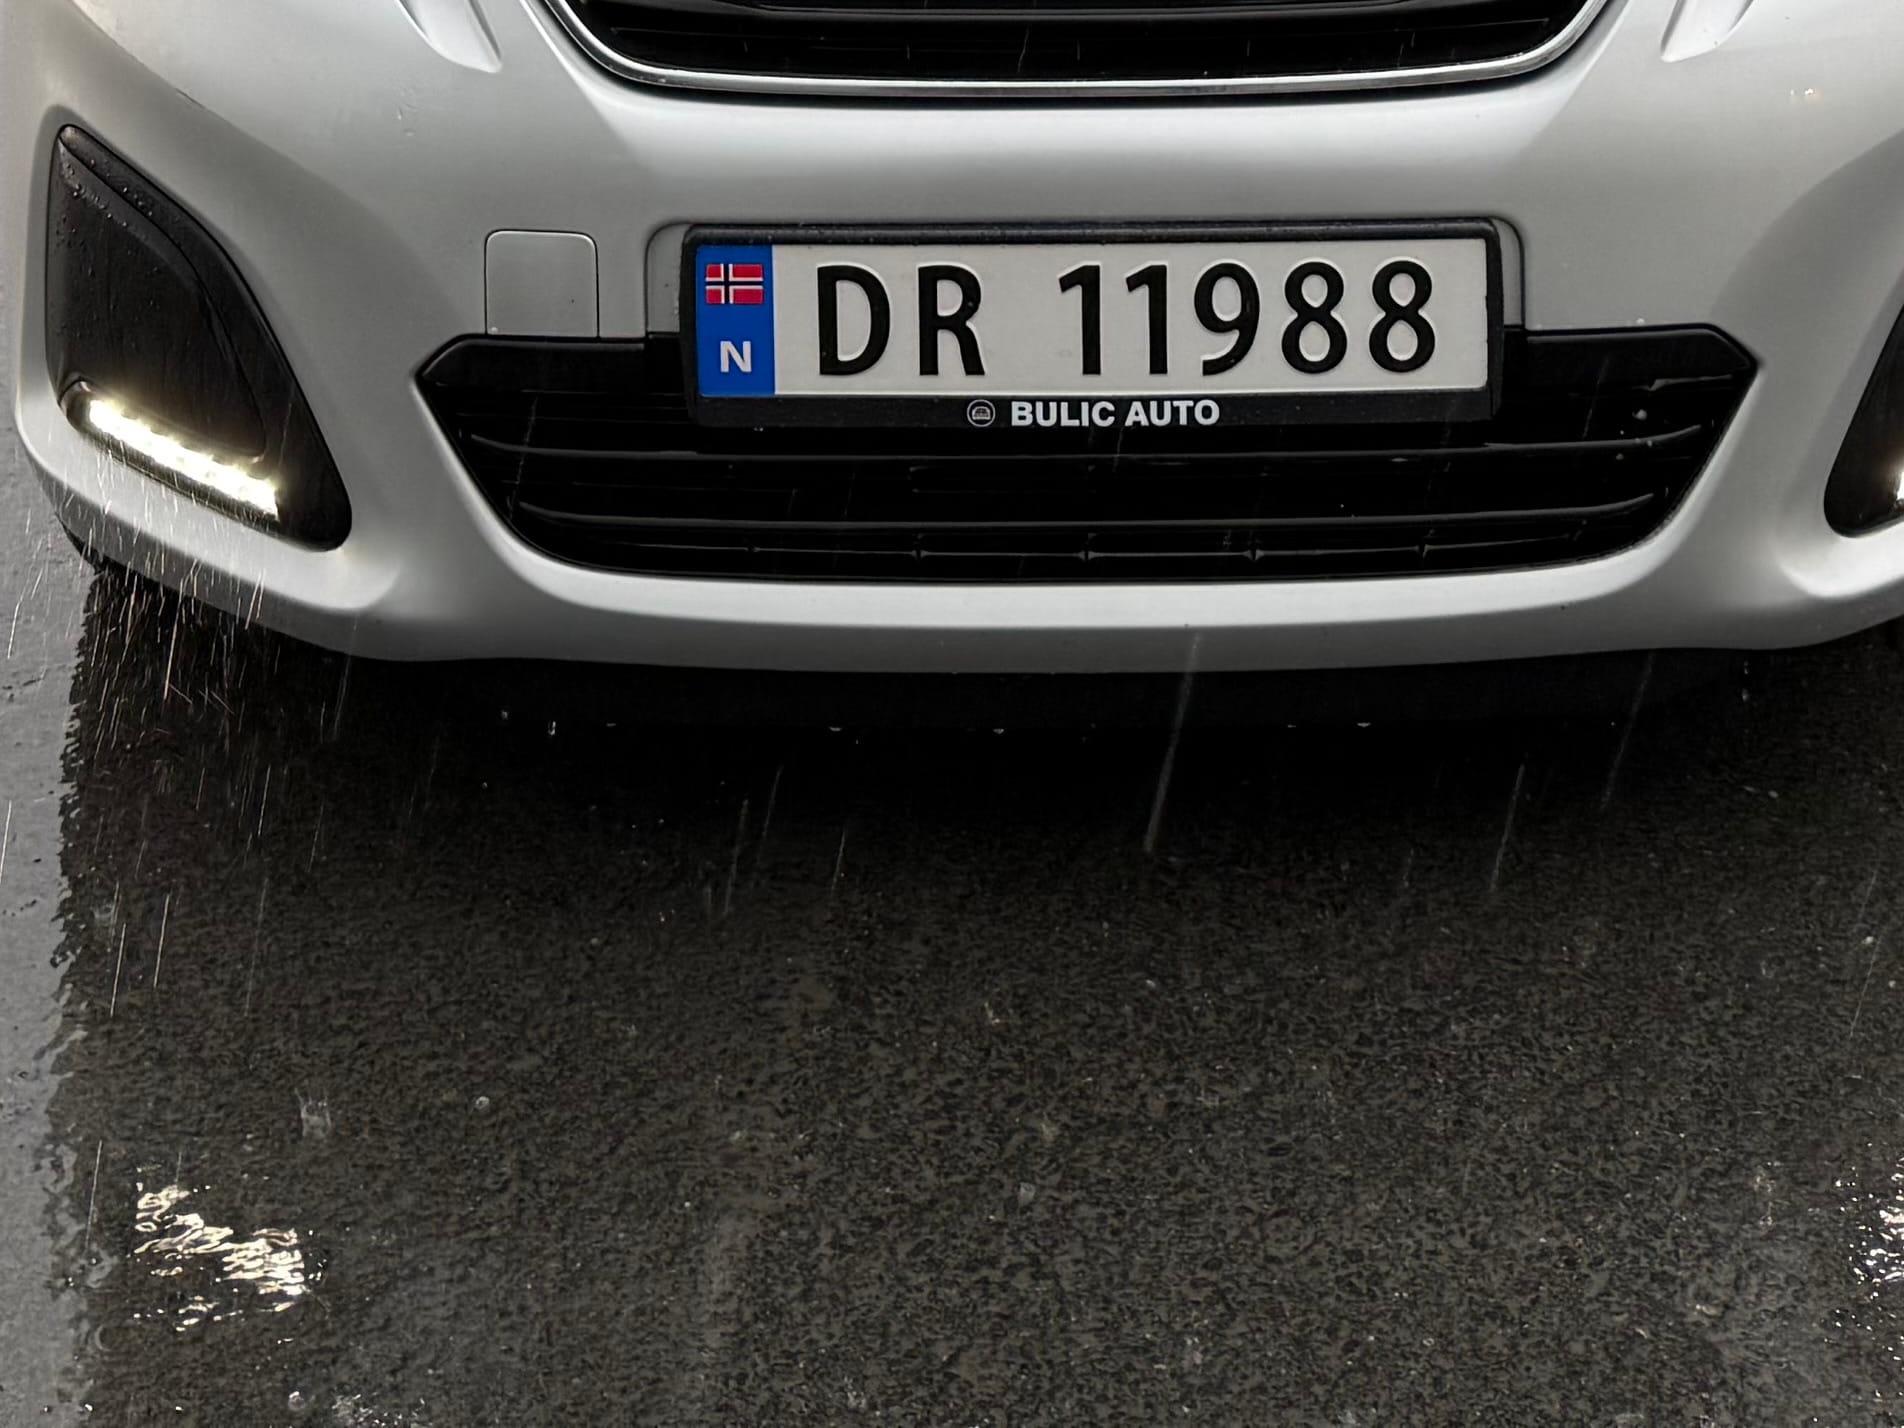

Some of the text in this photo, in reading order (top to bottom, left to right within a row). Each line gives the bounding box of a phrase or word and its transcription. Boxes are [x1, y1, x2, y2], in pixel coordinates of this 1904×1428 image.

[816, 259, 1436, 377] DR 11988
[720, 341, 752, 373] N
[1011, 399, 1220, 427] BULIC AUTO
